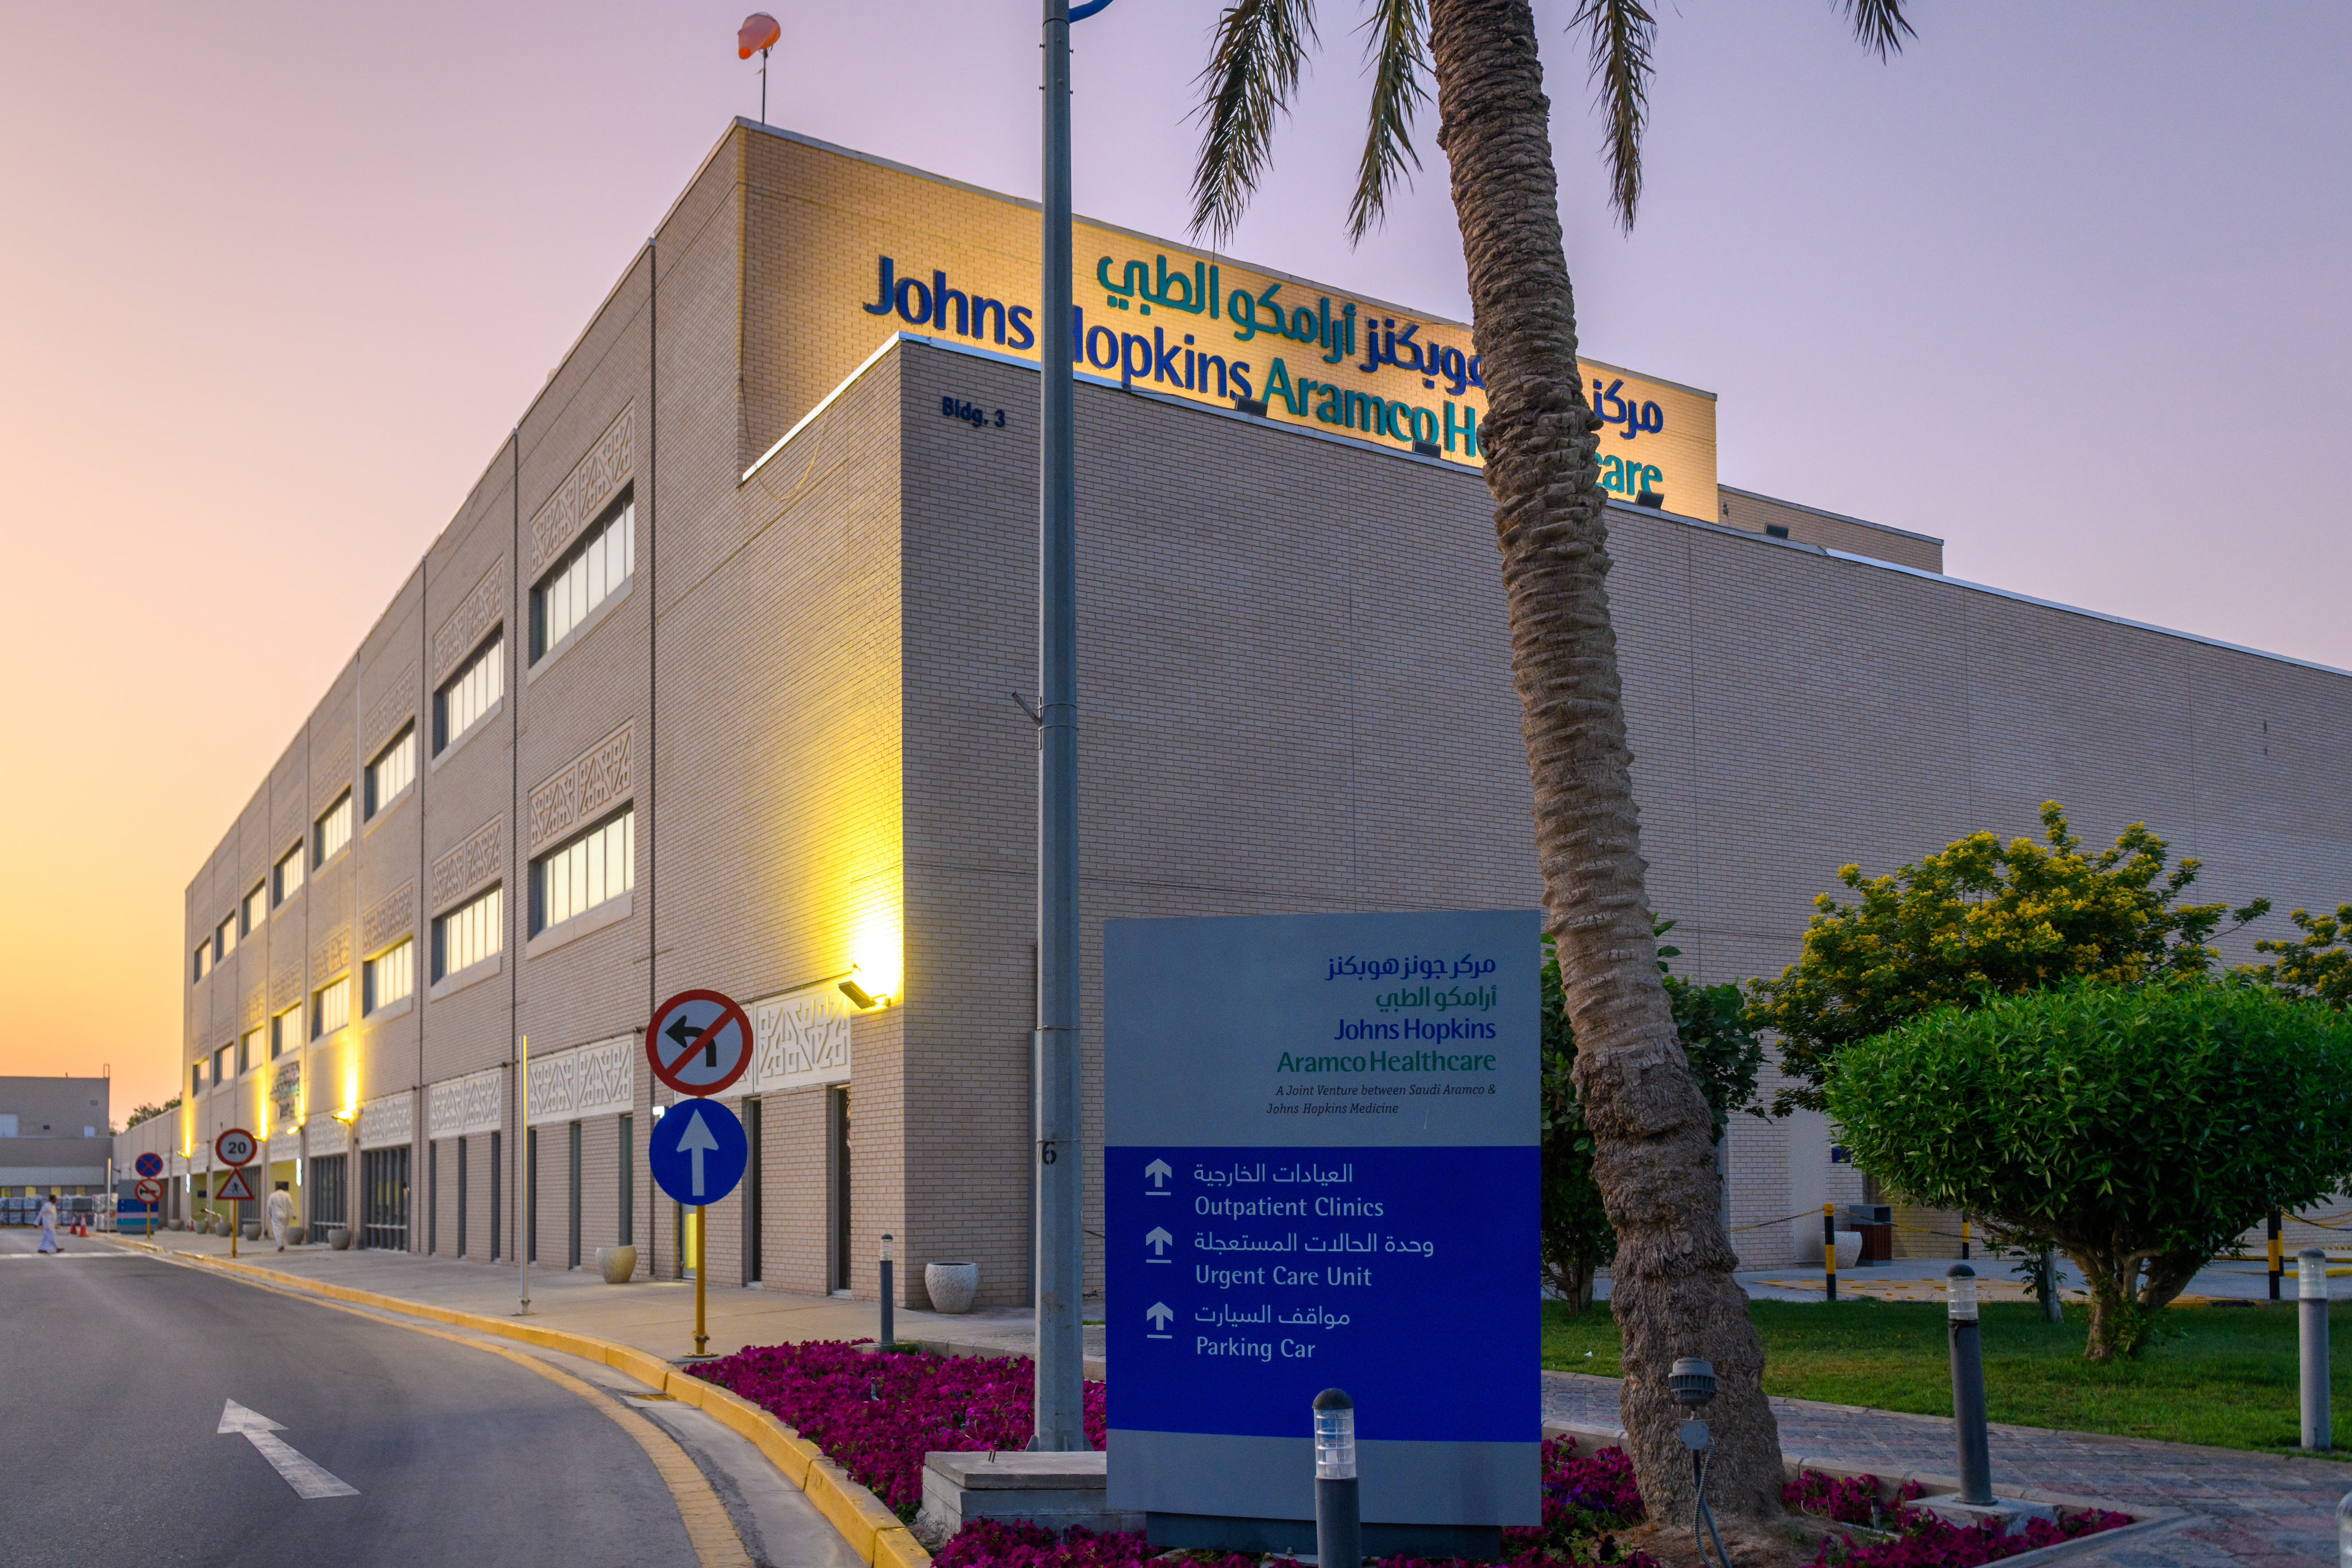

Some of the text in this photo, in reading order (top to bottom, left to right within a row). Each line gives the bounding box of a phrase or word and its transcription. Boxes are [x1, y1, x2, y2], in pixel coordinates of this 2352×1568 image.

[1097, 254, 1219, 319] الطبي
[1228, 284, 1356, 364] أرامكو
[863, 255, 1035, 350] Johns
[1263, 358, 1440, 444] Aramco
[942, 396, 1005, 427] Bldg. 3
[1325, 955, 1399, 981] هوبكنز
[1400, 955, 1448, 979] جونز
[1376, 985, 1497, 1013] أرامكو الطبي
[1334, 1018, 1496, 1044] Johns Hopkins
[1277, 1051, 1496, 1073] Aramco Healthcare
[1276, 1083, 1496, 1096] A Joint Venture between Saudi Aramco &
[1266, 1102, 1399, 1116] Johns Hopkins Medicine
[228, 1141, 246, 1155] 20
[1194, 1164, 1352, 1186] العيادات الخارجية
[1195, 1196, 1384, 1221] Outpatient Clinics
[1194, 1232, 1434, 1257] وحدة الحالات المستعجلة
[1196, 1265, 1372, 1289] Urgent Care Unit
[1278, 1306, 1350, 1329] مواقف
[1197, 1336, 1316, 1362] Parking Car
